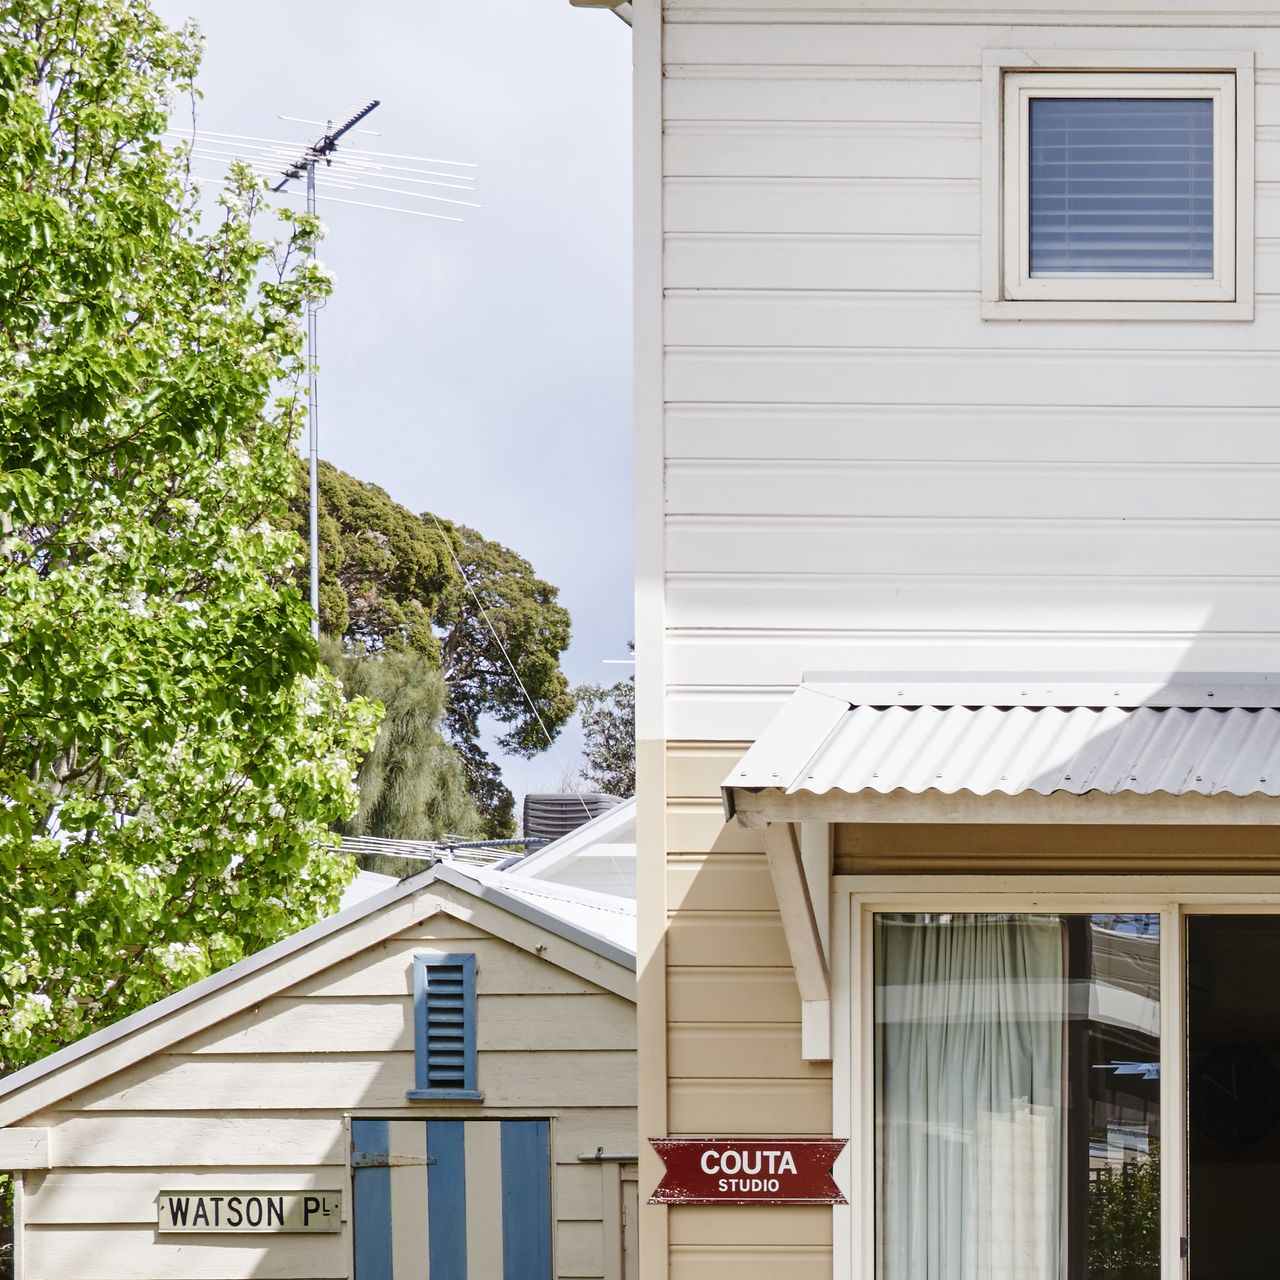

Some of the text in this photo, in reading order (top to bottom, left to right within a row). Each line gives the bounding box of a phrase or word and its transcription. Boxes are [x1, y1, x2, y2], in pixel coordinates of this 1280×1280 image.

[700, 1150, 797, 1175] COUTA
[718, 1178, 780, 1192] STUDIO
[168, 1197, 285, 1227] WATSON
